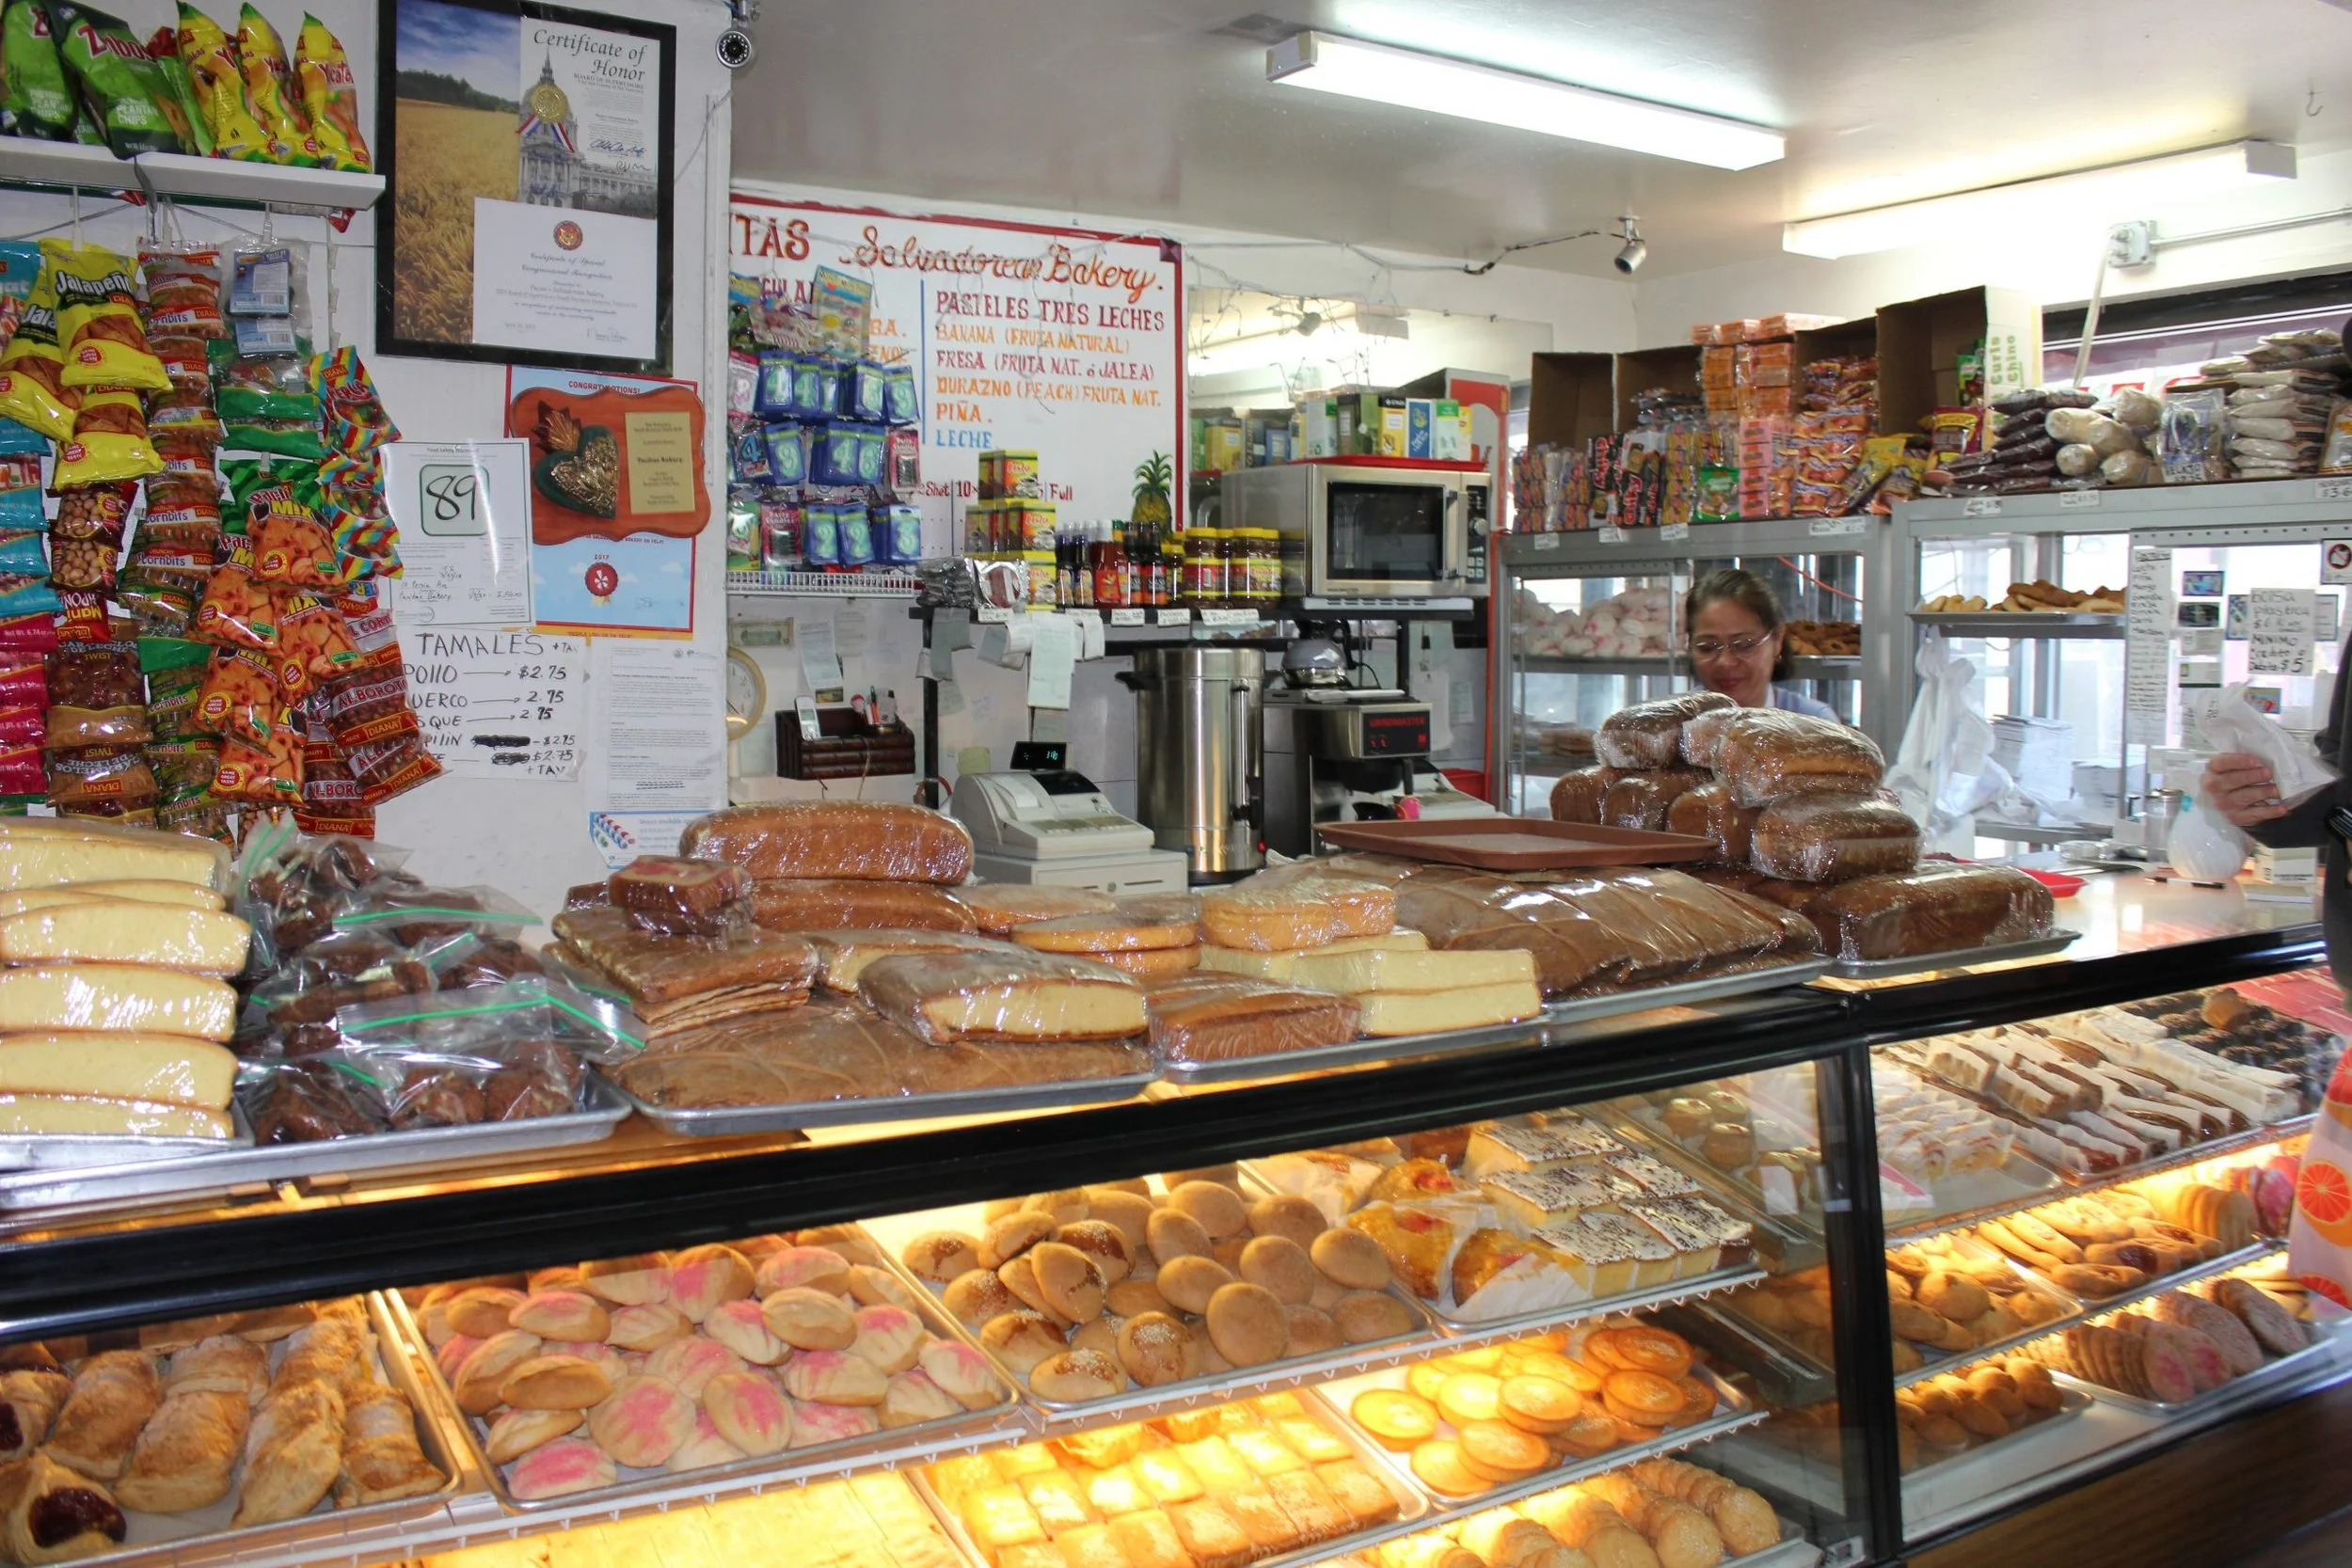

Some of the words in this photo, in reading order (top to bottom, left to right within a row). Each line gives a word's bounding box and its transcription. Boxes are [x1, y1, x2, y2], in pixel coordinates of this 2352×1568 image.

[532, 28, 623, 56] Certificate
[628, 45, 648, 68] of
[592, 59, 646, 81] Honor
[935, 290, 1028, 320] PASTELES
[1040, 298, 1089, 325] TRES
[1099, 305, 1165, 331] LECHES
[935, 324, 995, 344] BANANA
[936, 349, 985, 370] FRESA
[994, 351, 1046, 374] (FRUTA
[1099, 360, 1155, 381] JALEA)
[935, 375, 1011, 397] DURAZNO
[1082, 385, 1126, 405] FRUTA
[425, 475, 479, 521] 89
[1050, 482, 1073, 501] Full
[142, 556, 186, 567] cornbits
[414, 633, 544, 658] TAMALES
[85, 652, 112, 660] TWIST
[518, 665, 566, 680] $2.75
[412, 692, 468, 709] UERCO
[527, 689, 564, 703] 2.75
[519, 707, 552, 720] 2.75
[368, 720, 401, 736] DIANA
[543, 735, 576, 746] $2.75
[85, 748, 114, 757] TWIST
[532, 749, 574, 761] $2.75
[84, 781, 119, 792] DIANA
[391, 764, 422, 791] DIANA
[318, 821, 349, 833] DIANA
